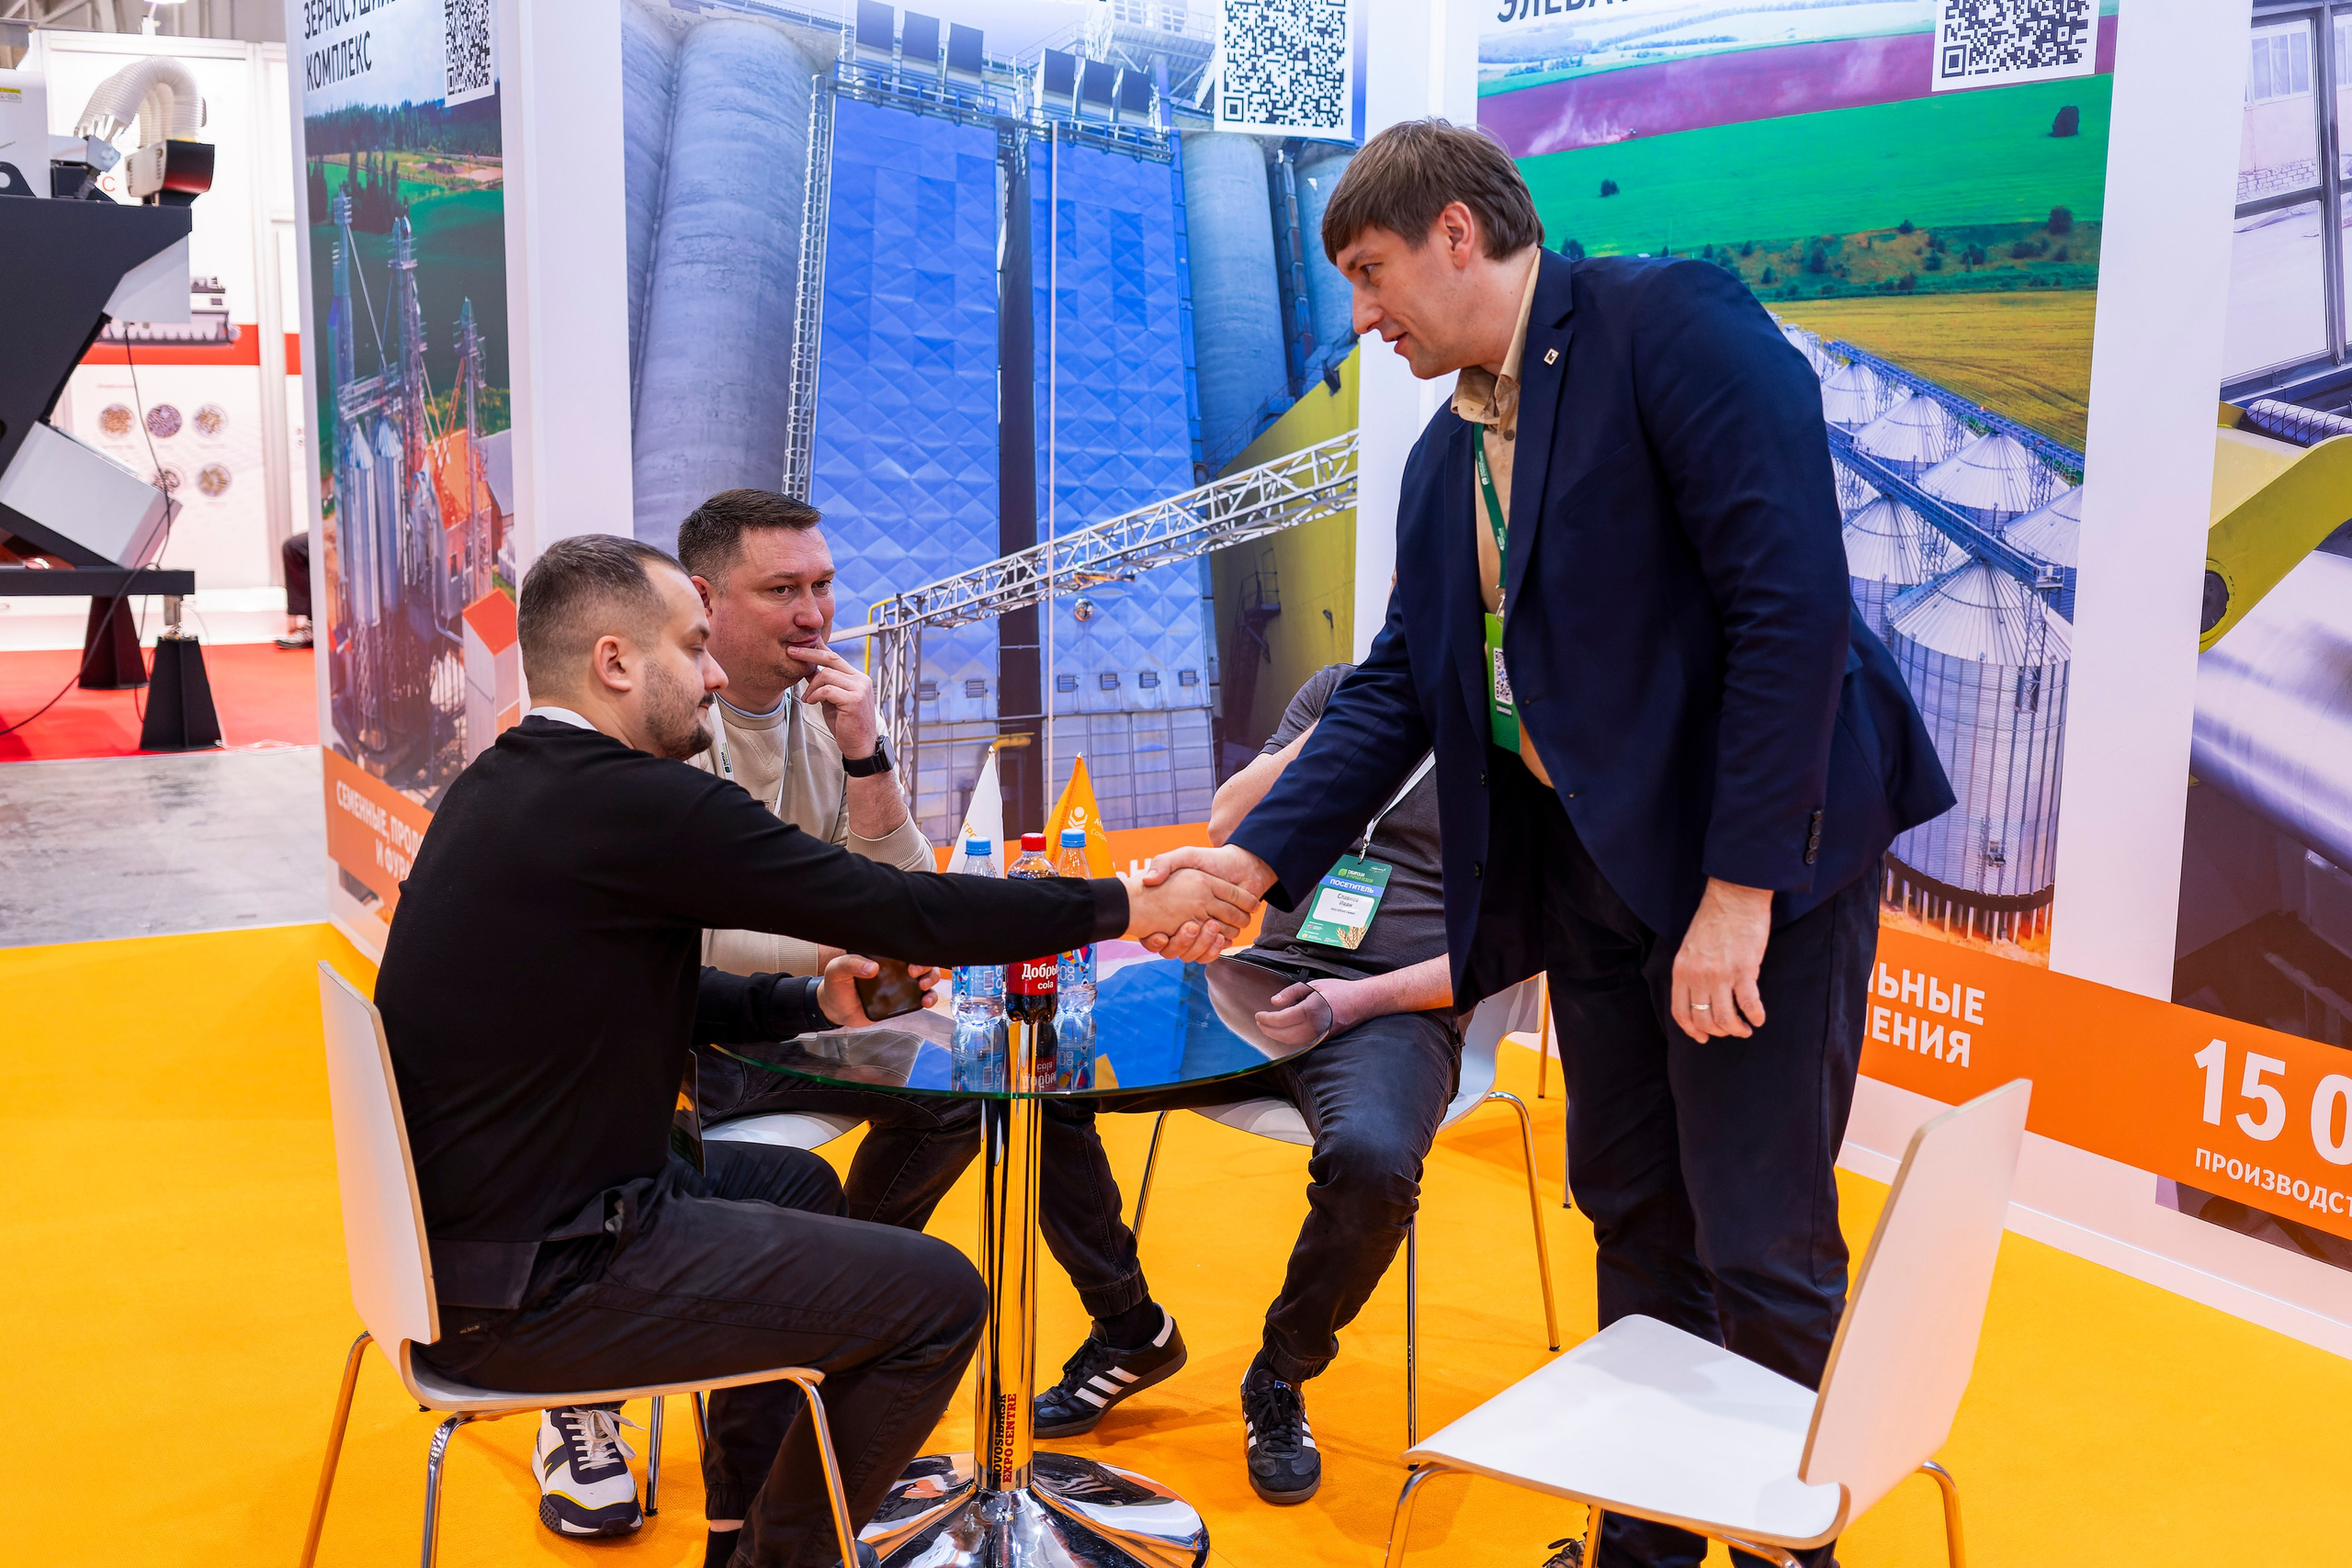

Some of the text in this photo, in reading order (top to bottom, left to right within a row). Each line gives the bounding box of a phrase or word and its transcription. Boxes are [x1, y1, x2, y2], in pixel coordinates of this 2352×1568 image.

[304, 0, 395, 39] ЗЕРНОСУ
[306, 30, 372, 92] КОМПЛЕКС
[336, 779, 424, 862] СЕМЕННЫЕ, ПРОД
[375, 838, 383, 868] И
[1329, 878, 1374, 894] ПОСЕТИТЕЛЬ
[1037, 980, 1054, 990] cola
[1864, 1003, 1972, 1068] ЕНИЯ
[2194, 1038, 2287, 1142] 15
[1002, 1393, 1017, 1483] EXPO CENTRE
